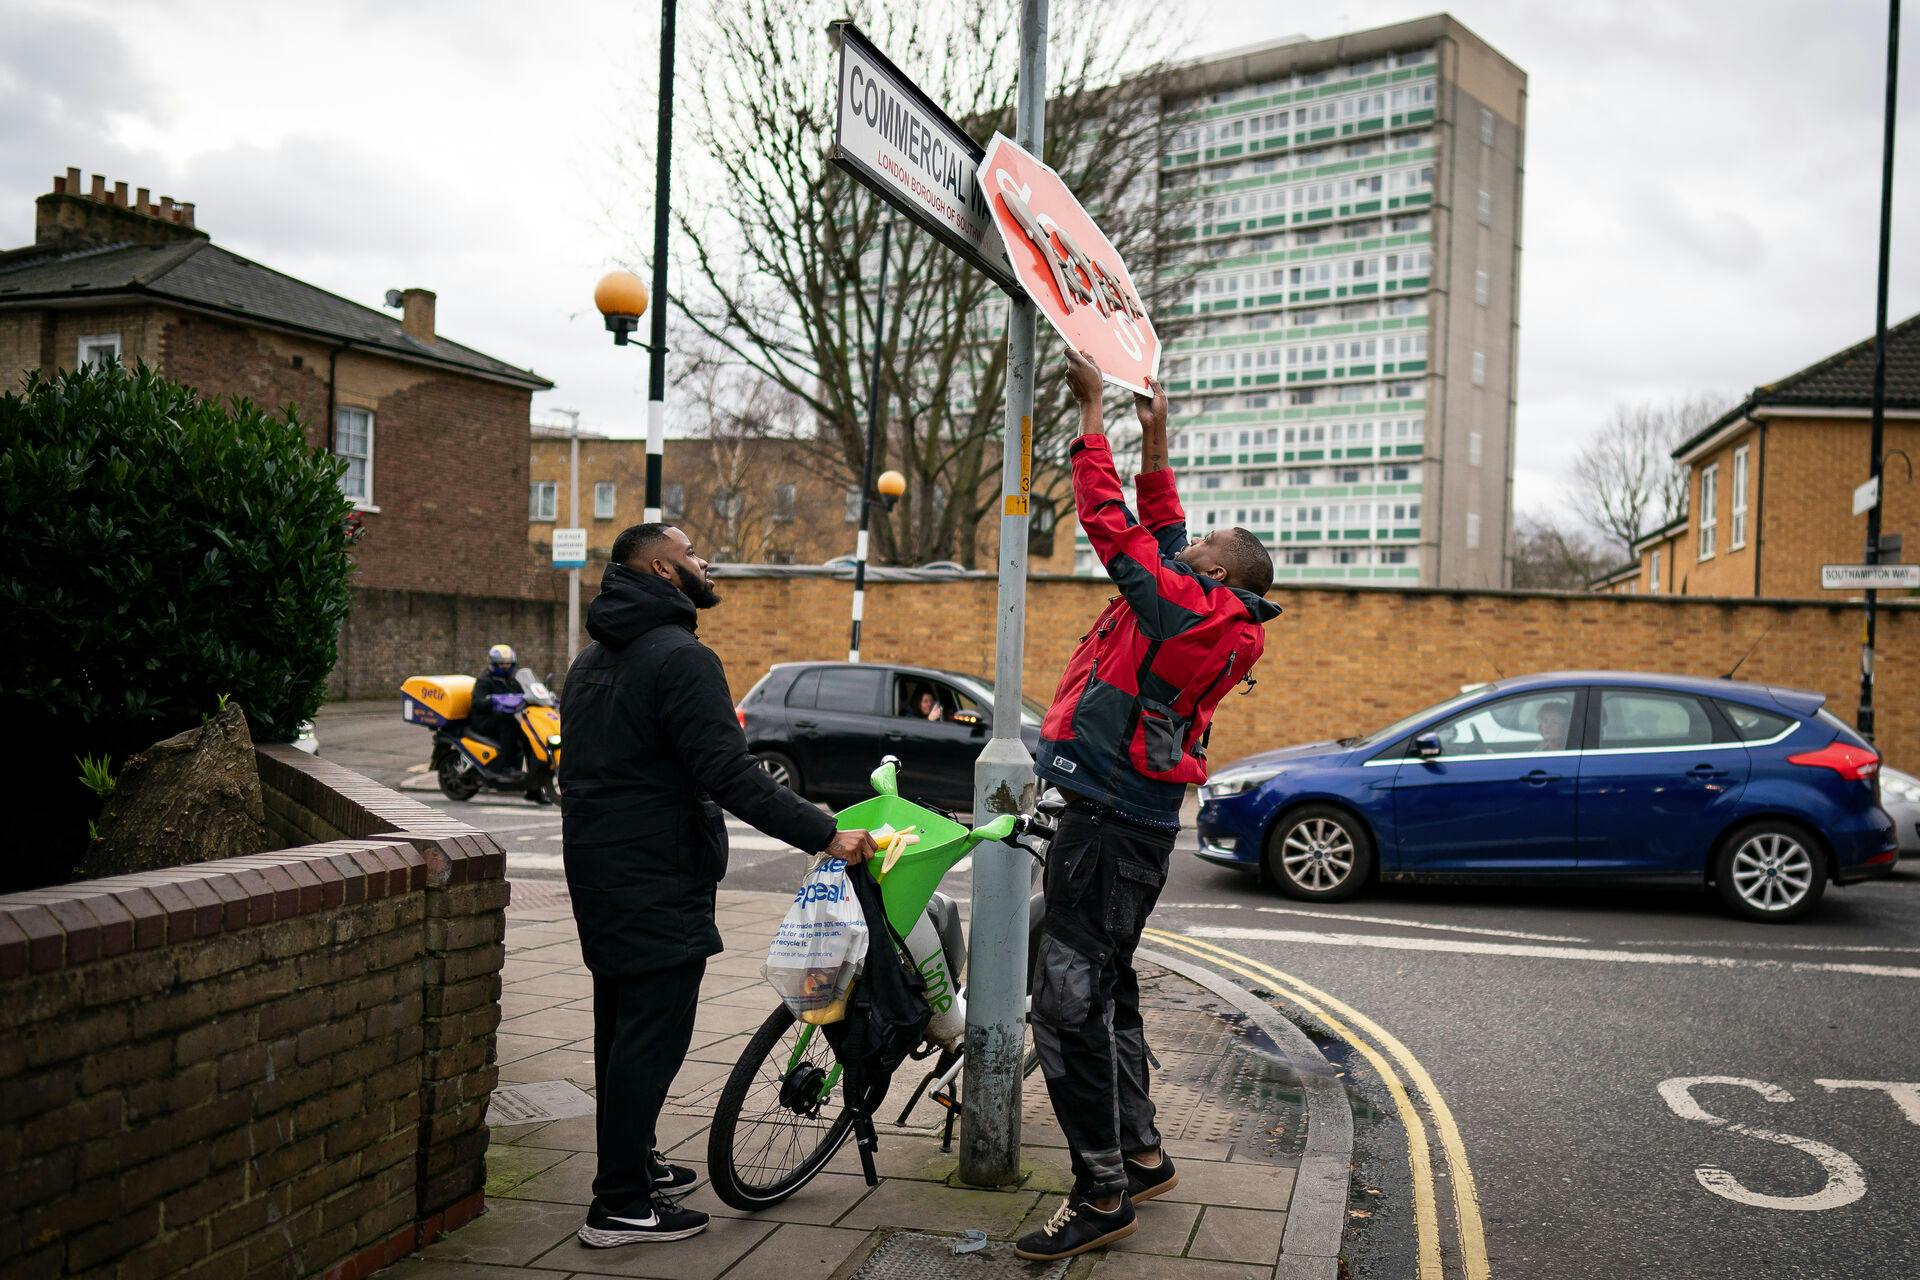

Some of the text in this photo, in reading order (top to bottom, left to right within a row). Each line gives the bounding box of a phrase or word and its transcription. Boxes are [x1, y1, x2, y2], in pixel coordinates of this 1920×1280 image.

[850, 64, 992, 224] COMMERCIAL WA
[877, 150, 985, 244] LONDON BOROUGH OF SOUTHW
[1825, 569, 1890, 579] SOUTHAMPTON
[1892, 569, 1910, 578] WAY
[421, 687, 445, 701] getir
